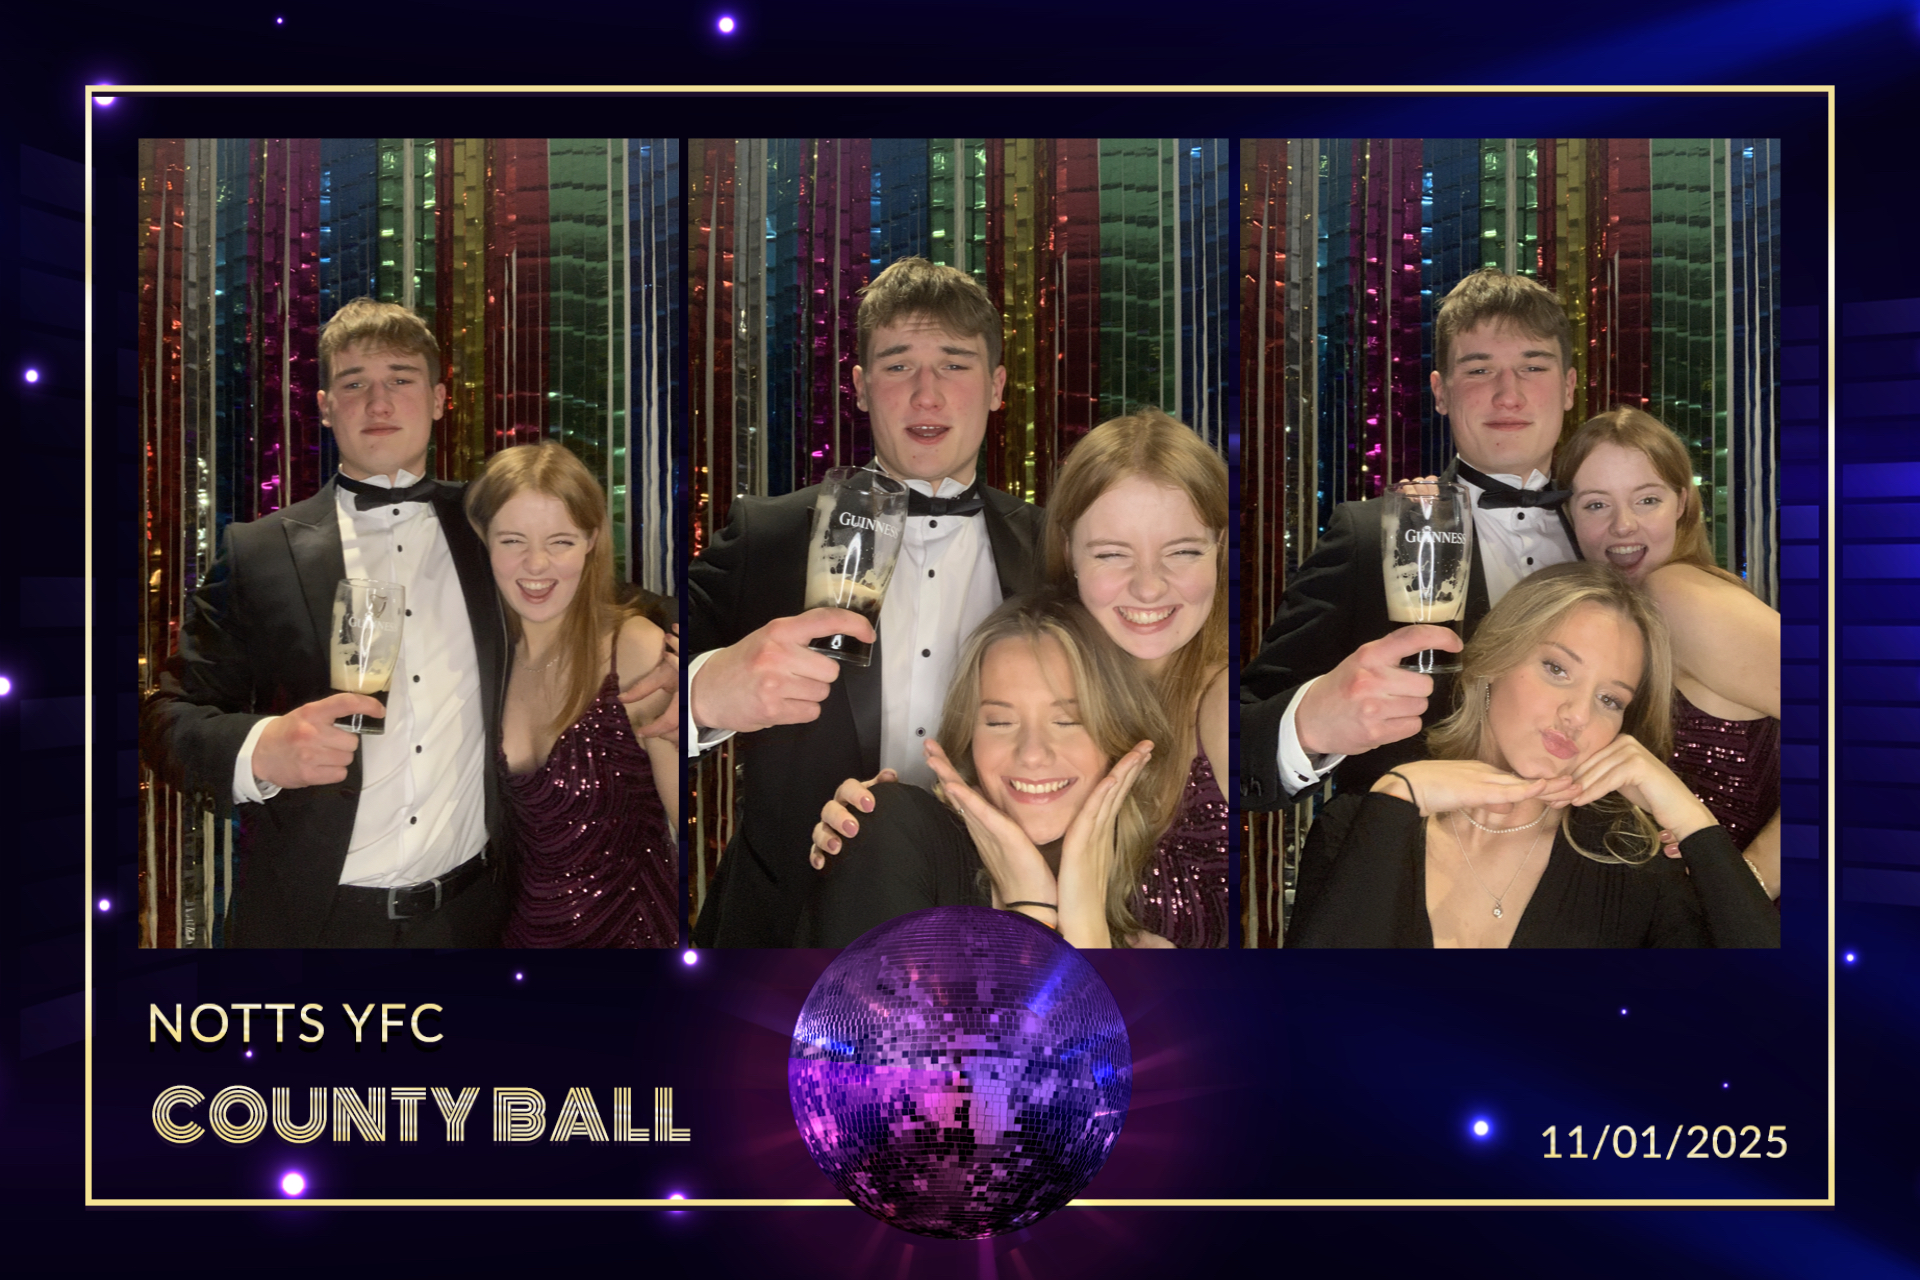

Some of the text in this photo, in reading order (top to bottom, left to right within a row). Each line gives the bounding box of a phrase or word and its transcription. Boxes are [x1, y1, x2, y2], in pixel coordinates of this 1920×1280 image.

[839, 511, 899, 539] GUINNESS
[1404, 529, 1467, 545] GUNNESS
[348, 616, 396, 632] GUNNES
